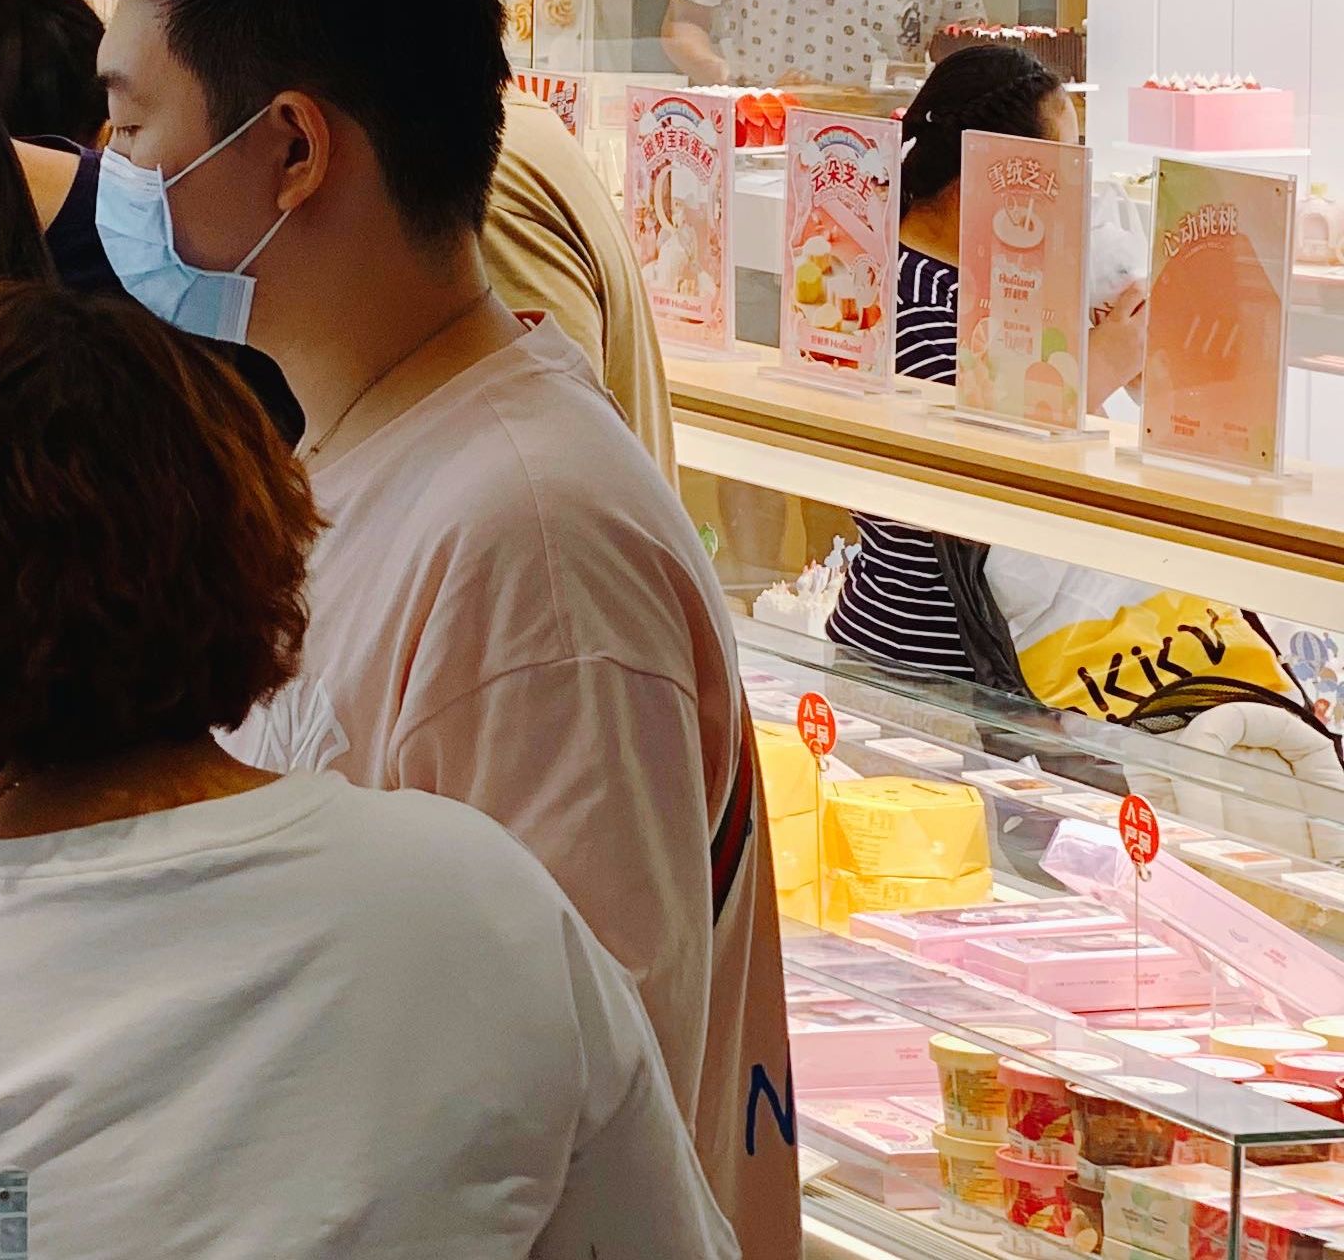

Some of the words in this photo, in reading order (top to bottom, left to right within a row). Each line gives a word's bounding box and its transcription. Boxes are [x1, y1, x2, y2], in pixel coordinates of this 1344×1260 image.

[811, 160, 872, 202] 云朵芝士
[987, 158, 1060, 199] 雪绒芝士
[1163, 205, 1238, 258] 心动桃桃
